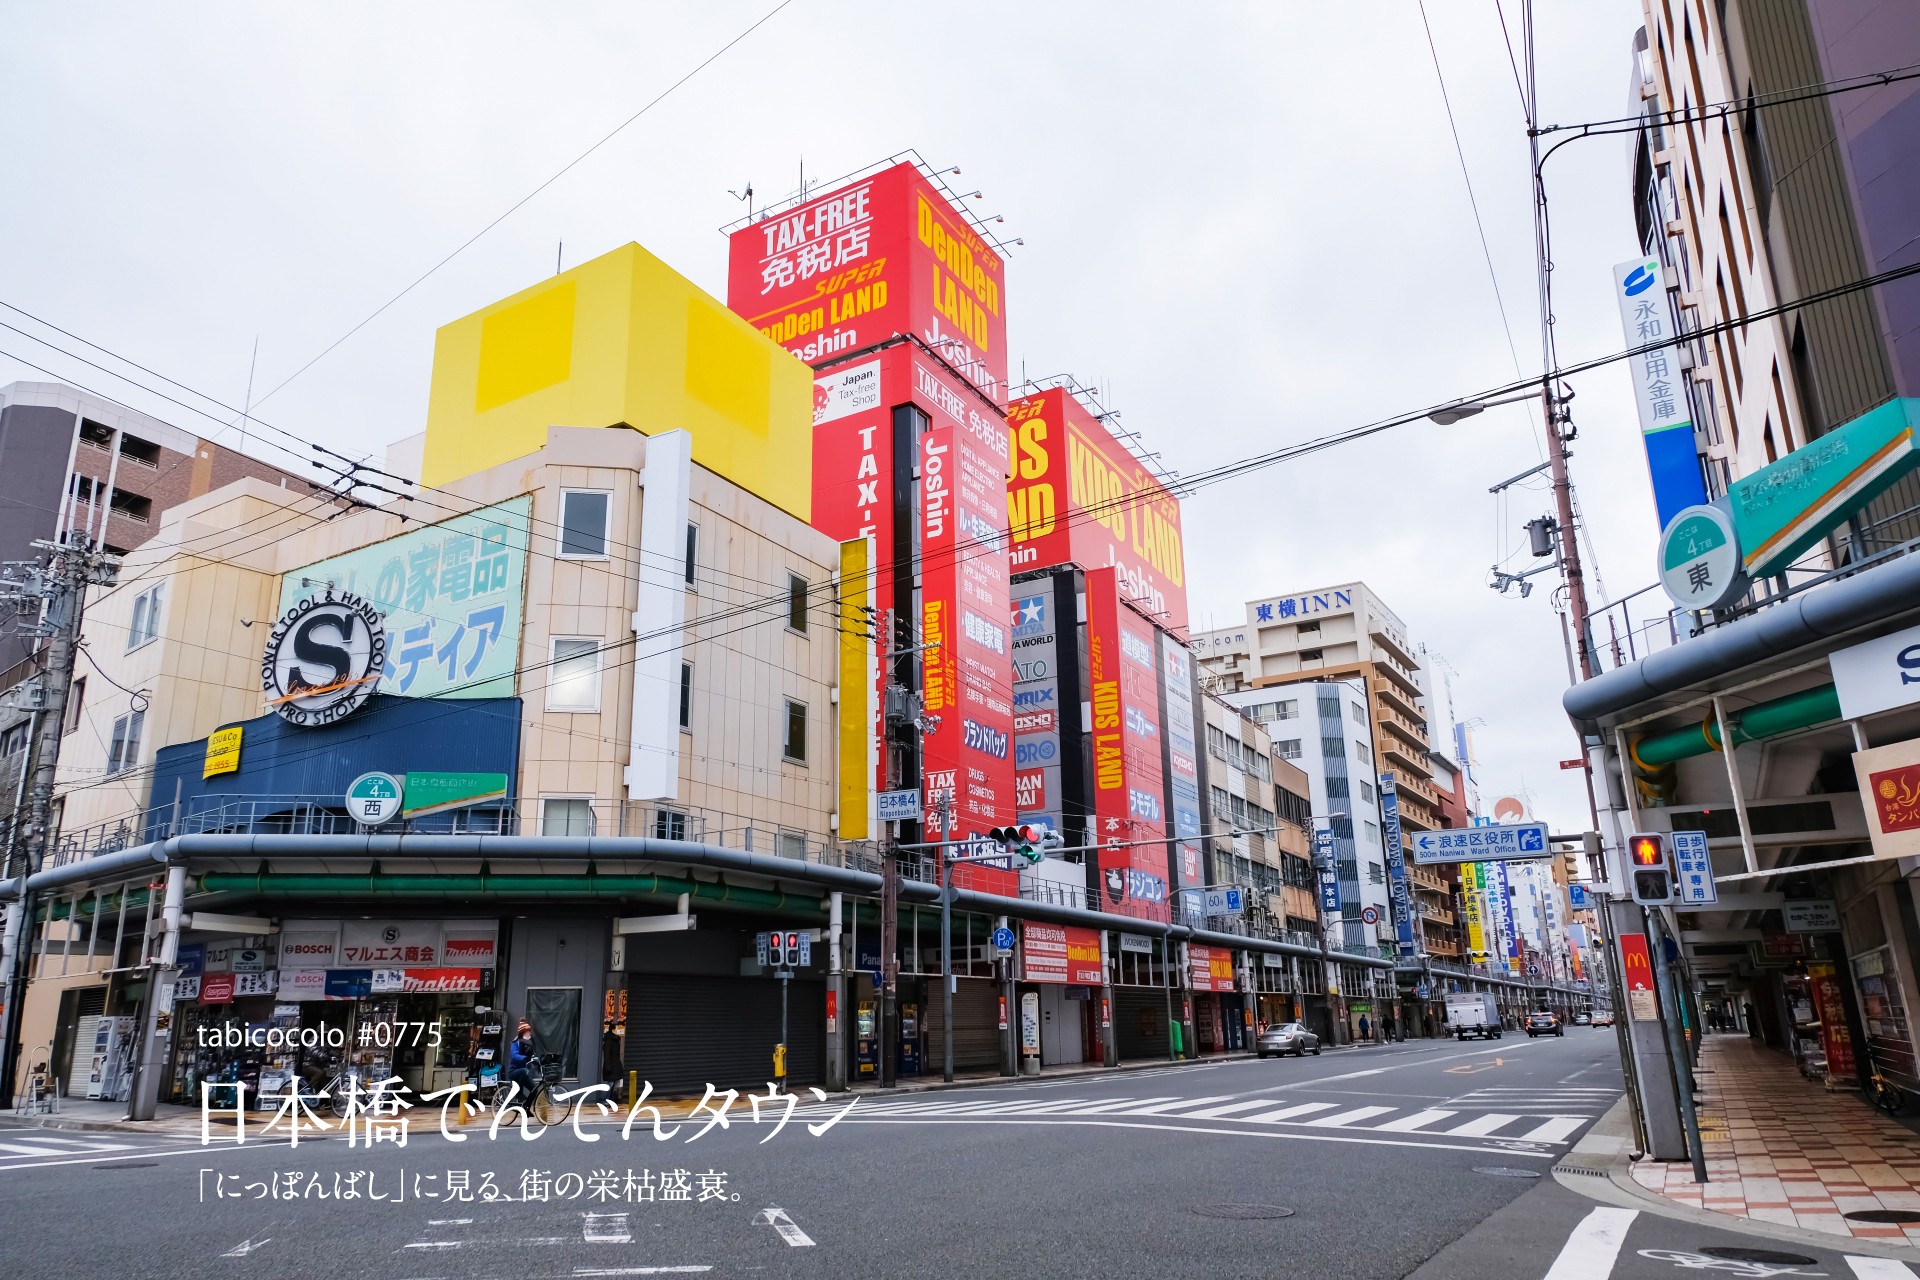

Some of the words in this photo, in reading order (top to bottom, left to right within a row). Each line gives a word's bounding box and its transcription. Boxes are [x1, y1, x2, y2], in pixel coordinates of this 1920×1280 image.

[763, 187, 871, 256] TAX-FREE
[760, 225, 871, 296] 免税店
[917, 195, 999, 318] DenDen
[814, 257, 887, 297] SUPER
[759, 307, 824, 345] enDen
[830, 280, 888, 324] LAND
[932, 262, 988, 353] LAND
[924, 315, 998, 400] Joshin
[1634, 299, 1677, 422] 永和信用金庫
[838, 381, 876, 401] Tax-free
[851, 393, 876, 408] Shop
[917, 366, 965, 425] TAX-FREE
[1007, 398, 1046, 422] PER
[968, 409, 1008, 460] 免税店
[925, 437, 949, 539] Joshin
[1068, 432, 1126, 543] KIDS
[1129, 488, 1183, 589] LAND
[1678, 525, 1699, 540] ここは
[1687, 537, 1713, 556] 4丁目
[1103, 543, 1166, 620] Joshin
[1686, 561, 1713, 594] 東
[1255, 589, 1352, 623] 東横INN
[261, 630, 286, 691] POWER
[278, 594, 320, 628] TOOL
[324, 590, 336, 603] &
[340, 591, 379, 626] HAND
[367, 626, 385, 674] TOOL
[924, 600, 943, 669] DenDen
[1021, 636, 1054, 647] WORLD
[287, 613, 355, 698] S
[1091, 635, 1103, 681] SUPER
[925, 668, 944, 711] LAND
[944, 658, 955, 707] SUPER
[278, 701, 308, 724] PRO
[313, 697, 357, 725] SHOP
[1093, 681, 1120, 730] KIDS
[963, 718, 1007, 758] ブランドバッグ
[968, 767, 984, 782] DRUGS
[1096, 733, 1123, 790] LAND
[369, 784, 391, 798] 4丁目
[927, 771, 956, 789] TAX
[927, 787, 956, 804] FRE
[968, 783, 995, 801] COSMETICS
[364, 800, 382, 817] 西
[880, 793, 917, 809] 日本橋4
[880, 808, 912, 819] Nipponbashi
[1105, 816, 1121, 852] 本店
[1385, 805, 1402, 868] WINDOWS
[1438, 830, 1514, 849] 浪速区役所
[1419, 850, 1438, 859] 500m
[1439, 849, 1466, 858] Naniwa
[1470, 847, 1490, 856] Ward
[1494, 845, 1517, 854] Office
[1677, 836, 1693, 872] 自転車
[1690, 835, 1706, 899] 歩行者専用
[1125, 868, 1166, 901] ラジコン
[1229, 892, 1237, 905] P
[294, 944, 333, 954] BOSCH
[385, 929, 397, 941] S
[997, 932, 1006, 947] P
[343, 945, 435, 962] マルエス商会
[445, 947, 492, 958] makita
[1067, 944, 1088, 961] DenDen
[1088, 947, 1100, 962] LAND
[1210, 959, 1221, 977] KIDS
[1221, 960, 1233, 978] LAND
[294, 975, 324, 983] BOSCH
[403, 975, 480, 992] makita
